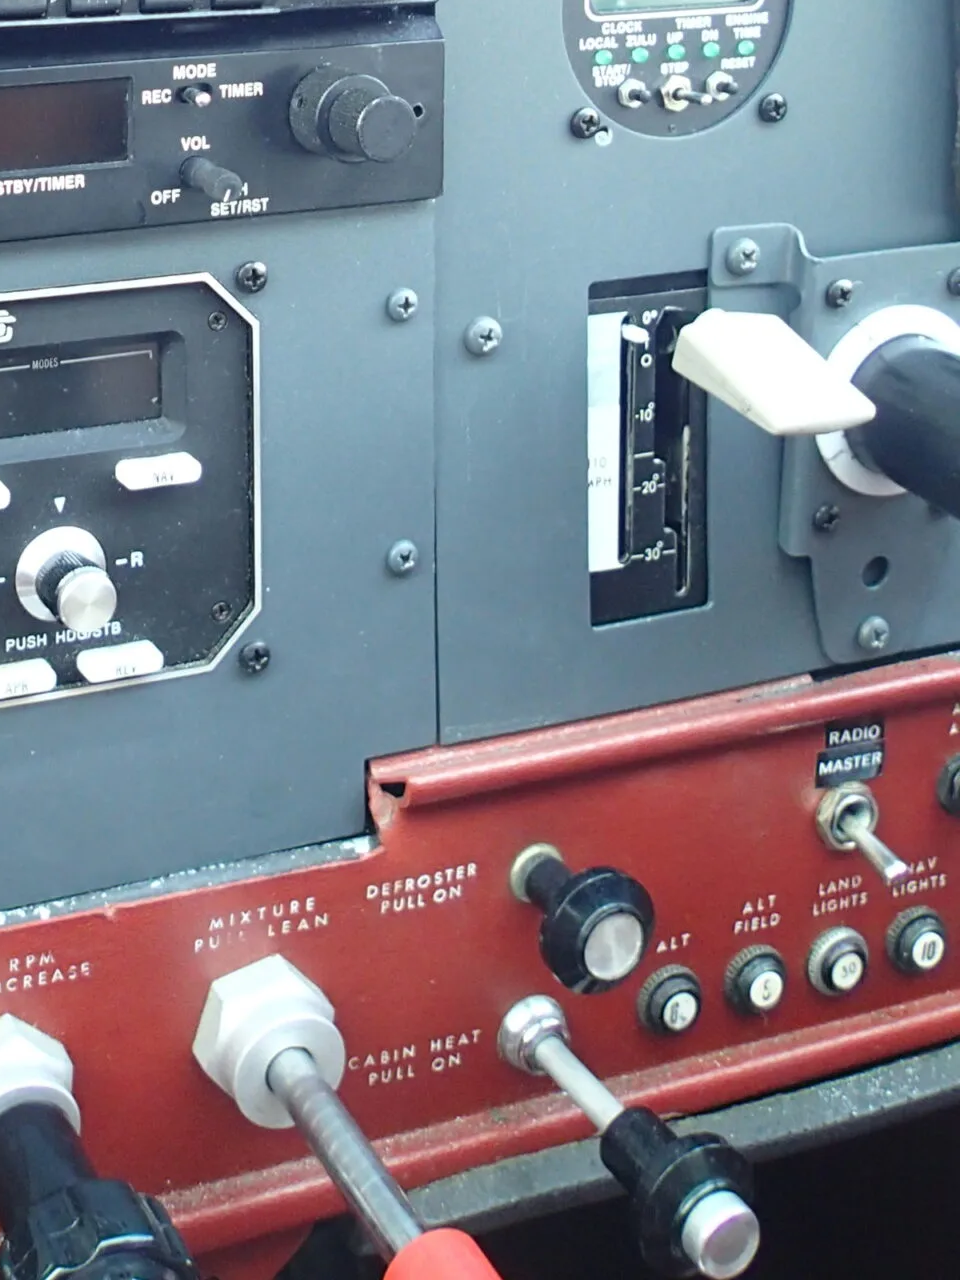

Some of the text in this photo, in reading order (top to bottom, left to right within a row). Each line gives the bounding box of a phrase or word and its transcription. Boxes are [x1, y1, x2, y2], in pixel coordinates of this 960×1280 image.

[601, 21, 642, 35] CLOCK
[666, 31, 683, 44] UP
[579, 37, 618, 51] LOCAL
[625, 33, 657, 47] ZULU
[172, 63, 217, 80] MODE
[142, 89, 172, 105] REC
[219, 82, 263, 99] TIMER
[181, 136, 210, 152] VOL
[150, 189, 181, 206] OFF
[210, 197, 269, 217] SET/RST
[32, 357, 59, 370] MODES
[5, 633, 47, 652] PUSH
[828, 724, 881, 747] RADIO
[818, 750, 883, 777] MASTER
[366, 862, 478, 900] DEFROSTER
[818, 875, 862, 897] LAND
[892, 873, 947, 898] LIGHTS
[380, 883, 463, 915] PULL ON
[742, 894, 777, 915] ALT
[812, 891, 869, 917] LIGHTS
[208, 896, 316, 933] MIXTURE
[268, 912, 329, 937] LEAN
[733, 913, 782, 935] FIELD
[656, 933, 691, 953] ALT
[922, 940, 937, 961] 10
[9, 950, 57, 973] RPM
[348, 1029, 482, 1071] CABIN HEAT
[368, 1053, 462, 1087] PULL ON
